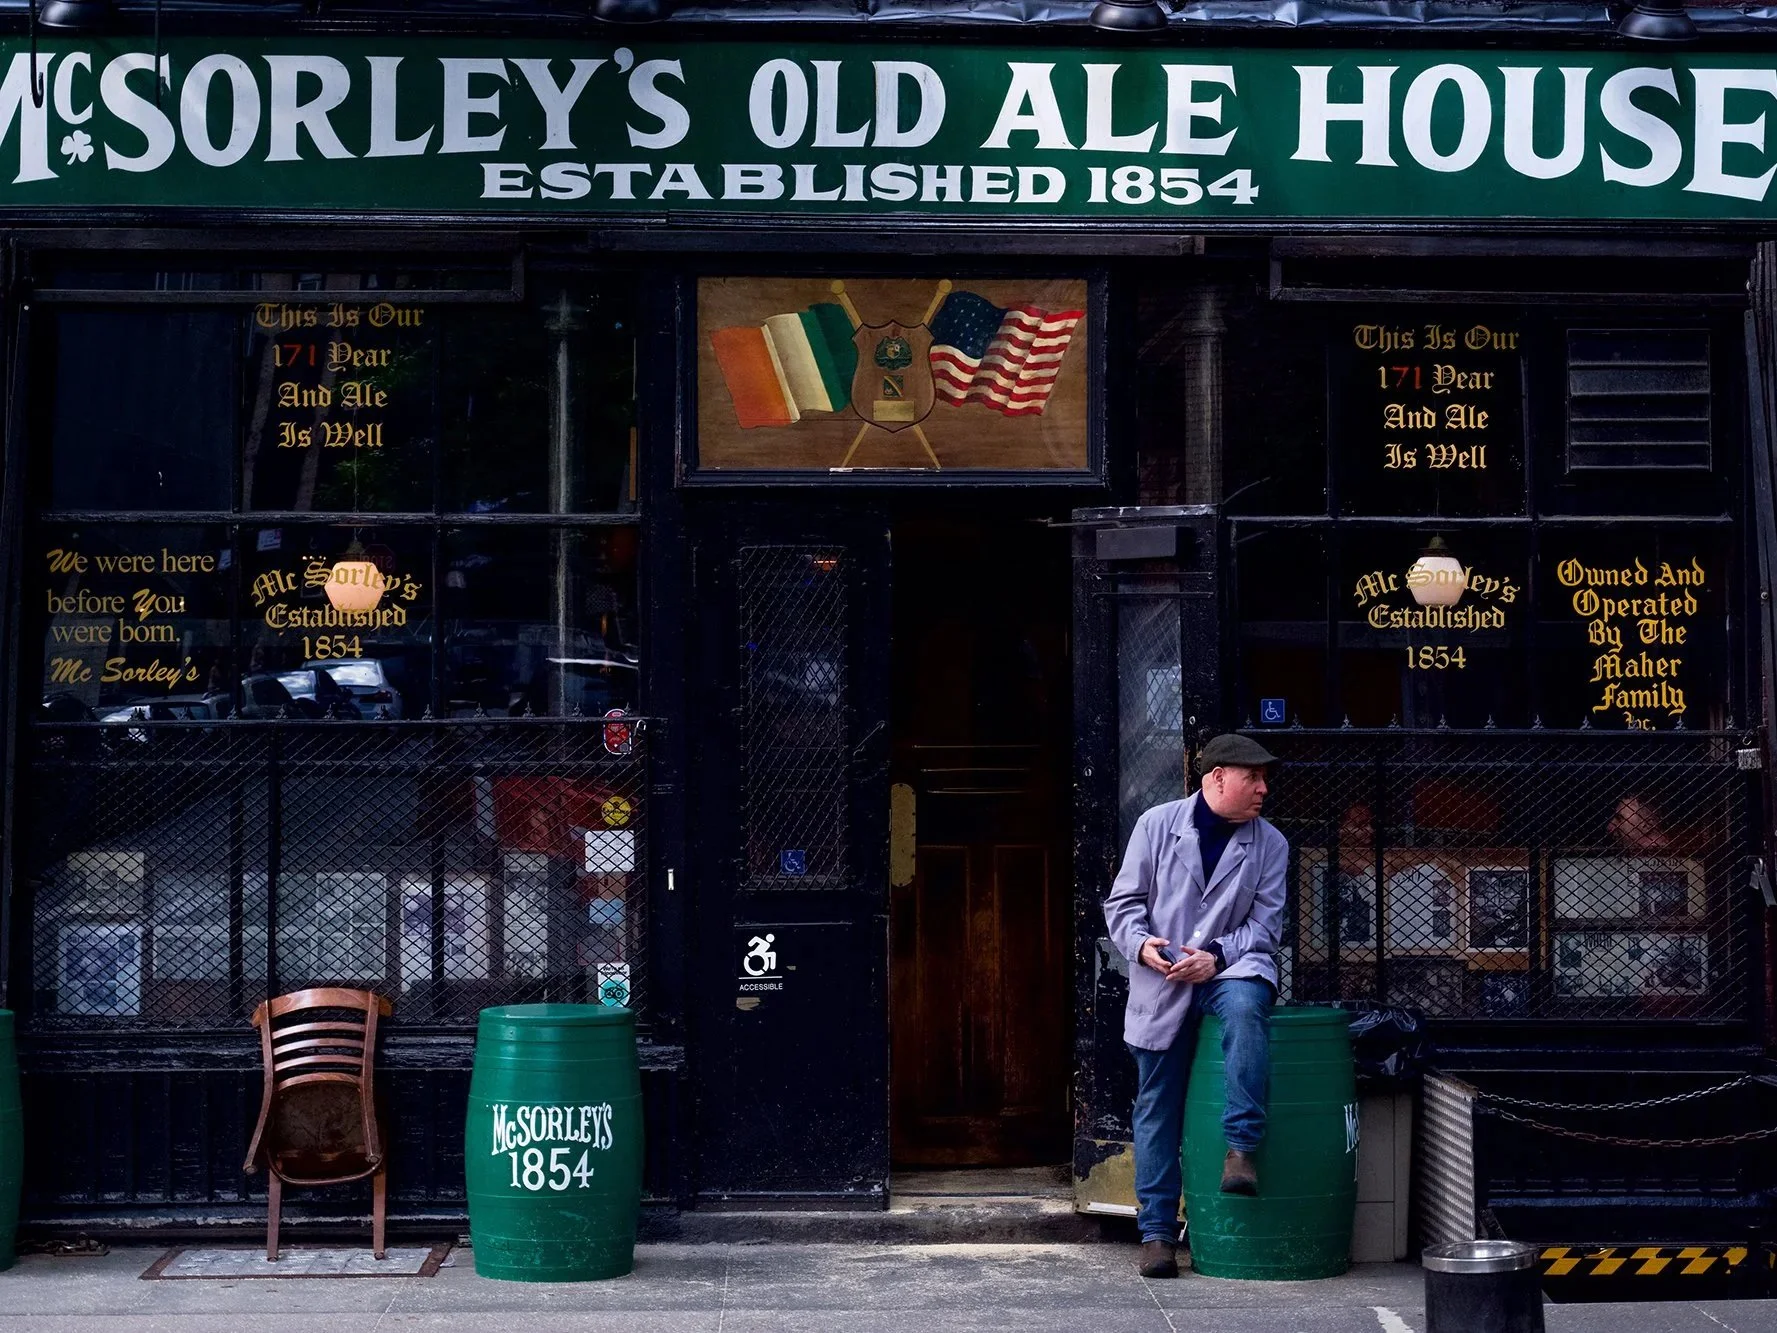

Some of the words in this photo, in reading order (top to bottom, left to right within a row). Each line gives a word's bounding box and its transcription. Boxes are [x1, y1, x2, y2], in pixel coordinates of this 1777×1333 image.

[749, 58, 946, 149] OLD
[980, 62, 1240, 160] ALE
[1290, 63, 1777, 202] HOUSE
[479, 163, 1067, 204] ESTABLISHED
[1086, 166, 1260, 205] 1854
[255, 303, 318, 332] This
[326, 303, 360, 328] Is
[368, 303, 425, 328] Our
[1353, 324, 1415, 354] This
[1423, 324, 1457, 350] Is
[1464, 325, 1520, 350] Our
[272, 343, 316, 367] 171
[327, 341, 392, 372] Year
[1378, 365, 1422, 389] 171
[1431, 364, 1495, 394] Year
[277, 382, 332, 408] And
[340, 382, 389, 408] Ale
[1384, 403, 1437, 429] And
[1445, 403, 1490, 429] Ale
[277, 421, 312, 448] Is
[320, 421, 384, 448] Well
[1384, 443, 1418, 469] Is
[1425, 443, 1487, 469] Well
[46, 548, 89, 573] We
[94, 555, 156, 573] were
[161, 548, 215, 573] here
[1557, 556, 1649, 587] Owned
[1654, 556, 1705, 587] And
[251, 569, 298, 607] Mc
[303, 561, 423, 601] Sorley's
[1354, 570, 1401, 608] Mc
[1405, 562, 1521, 604] Sorley's
[47, 589, 125, 614] before
[132, 588, 187, 622] You
[265, 602, 407, 631] Established
[1367, 603, 1506, 633] Established
[1572, 587, 1698, 623] Operated
[53, 625, 112, 643] were
[118, 618, 181, 643] born.
[1588, 618, 1624, 654] By
[1636, 618, 1687, 645] The
[302, 634, 363, 660] 1854
[1405, 645, 1467, 670] 1854
[50, 656, 93, 684] Mc
[100, 656, 200, 690] Sorley's
[1590, 651, 1682, 683] Maher
[1592, 680, 1687, 717] Family
[1623, 711, 1657, 731] Inc.
[739, 983, 783, 991] ACCESSIBLE
[491, 1102, 613, 1156] McSORLEY'S
[508, 1147, 595, 1191] 1854
